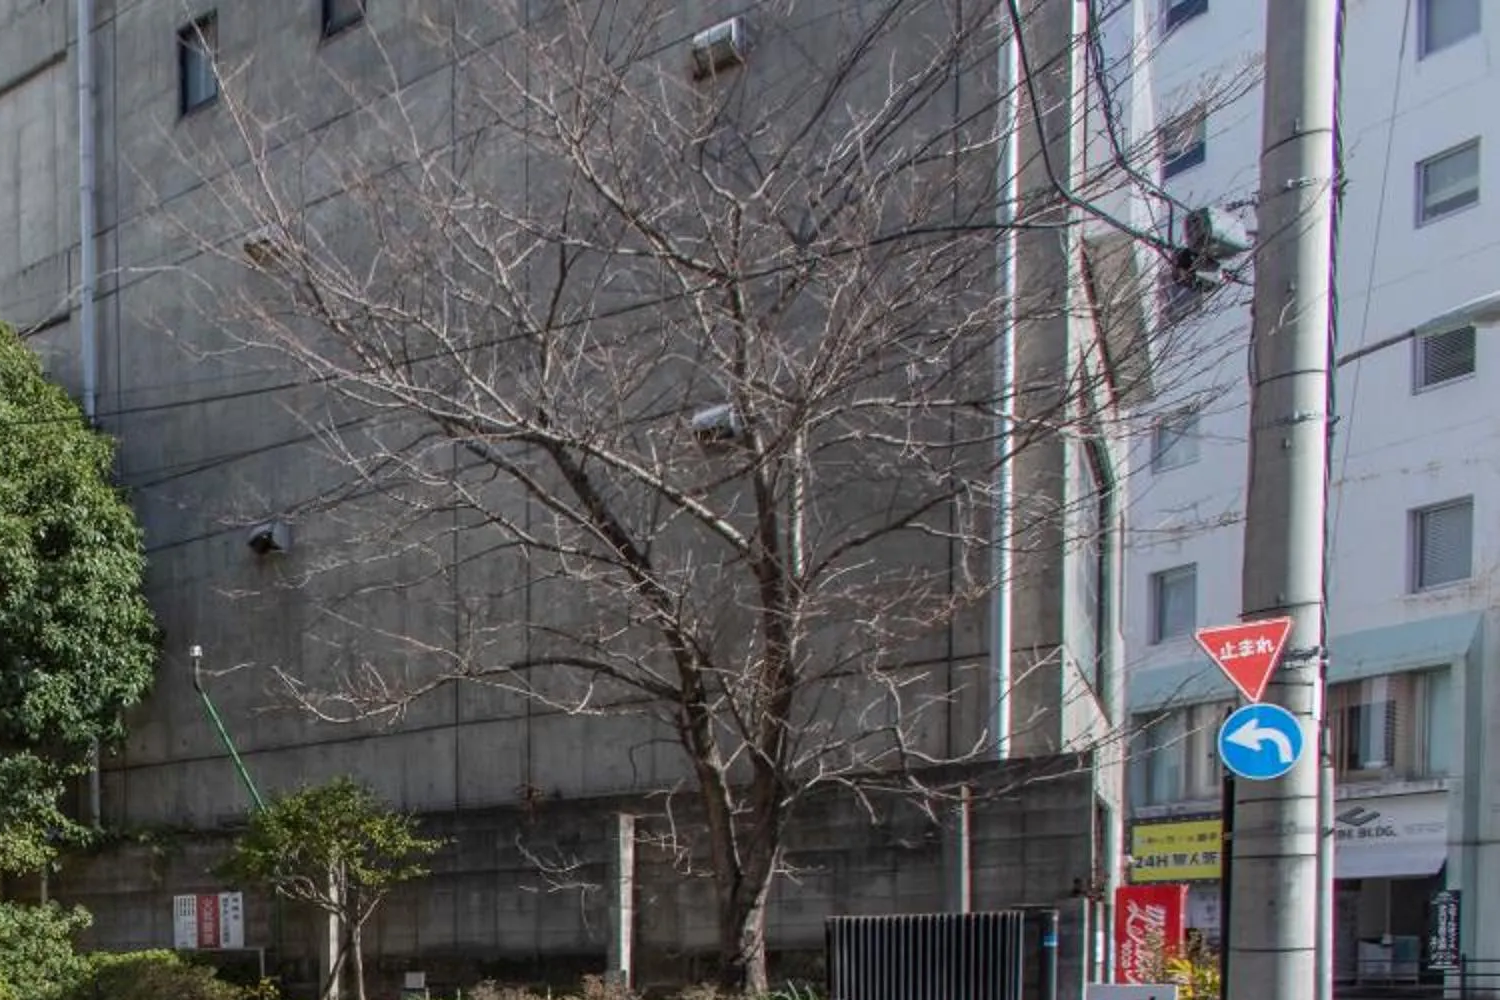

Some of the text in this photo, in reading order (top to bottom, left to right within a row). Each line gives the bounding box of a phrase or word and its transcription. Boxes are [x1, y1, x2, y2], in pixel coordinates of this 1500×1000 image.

[1219, 635, 1275, 660] 止まれ
[1132, 854, 1169, 869] 24H
